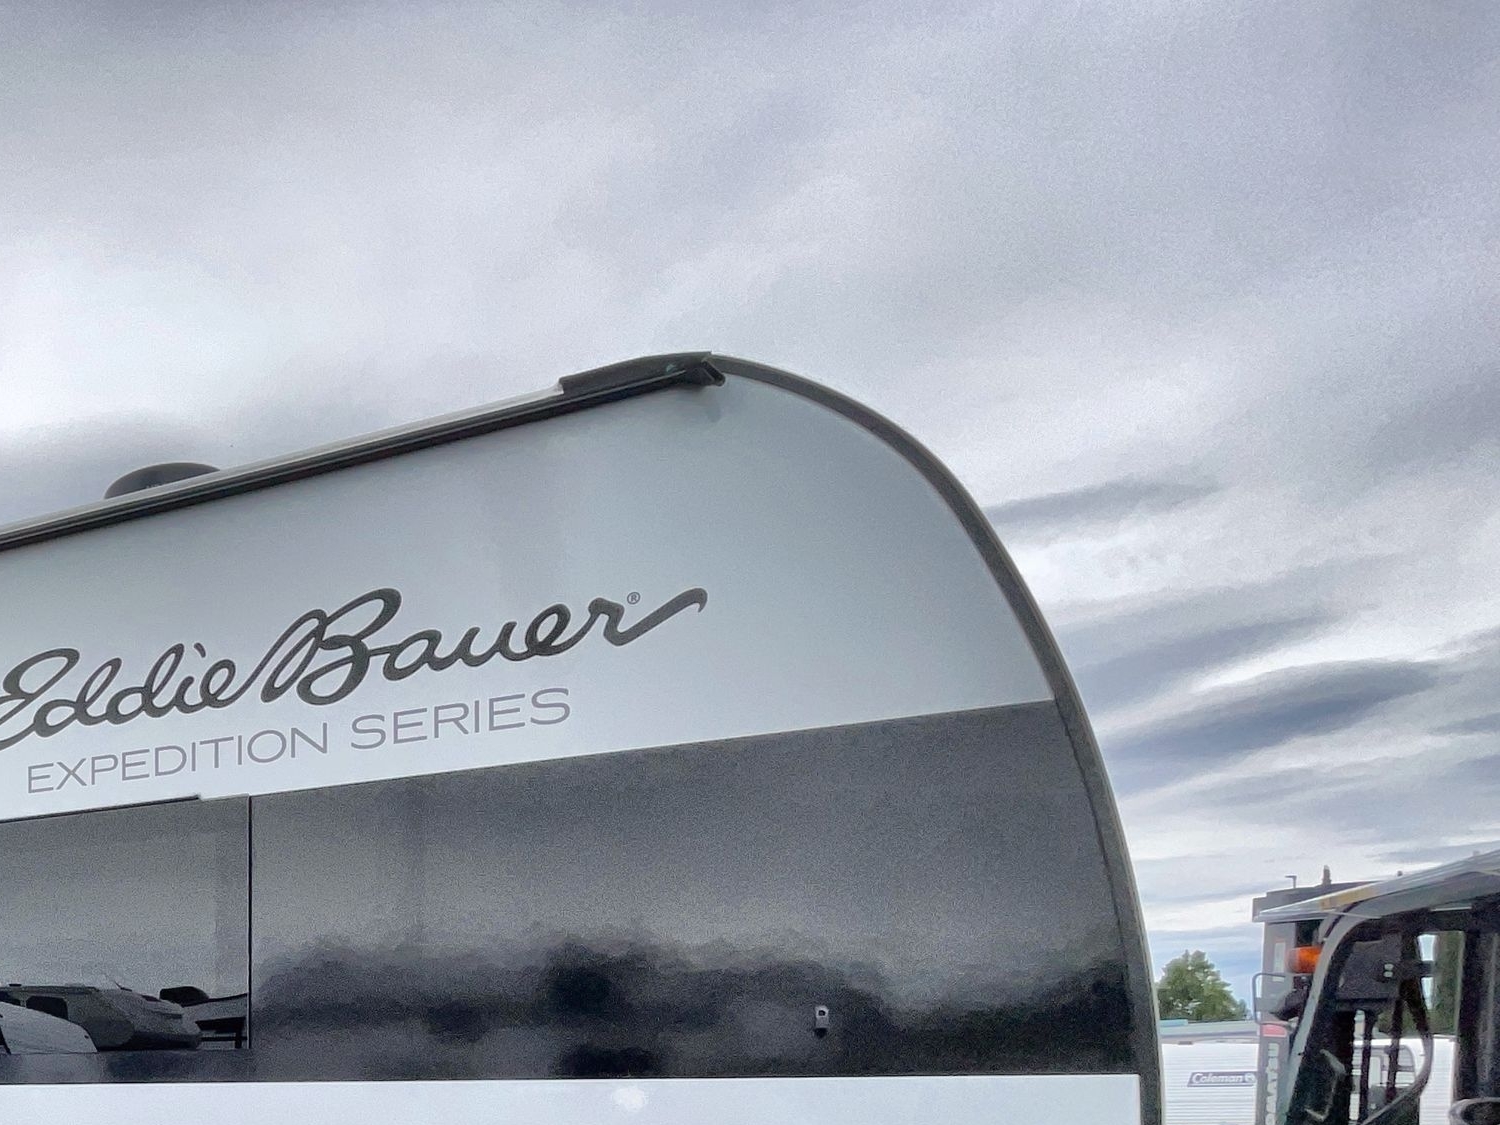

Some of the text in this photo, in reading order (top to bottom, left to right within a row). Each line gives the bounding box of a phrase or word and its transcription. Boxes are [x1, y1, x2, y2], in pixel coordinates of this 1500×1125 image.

[258, 587, 708, 706] Bauer
[26, 687, 571, 795] EXPEDITION SERIES
[1192, 1072, 1243, 1083] Coleman
